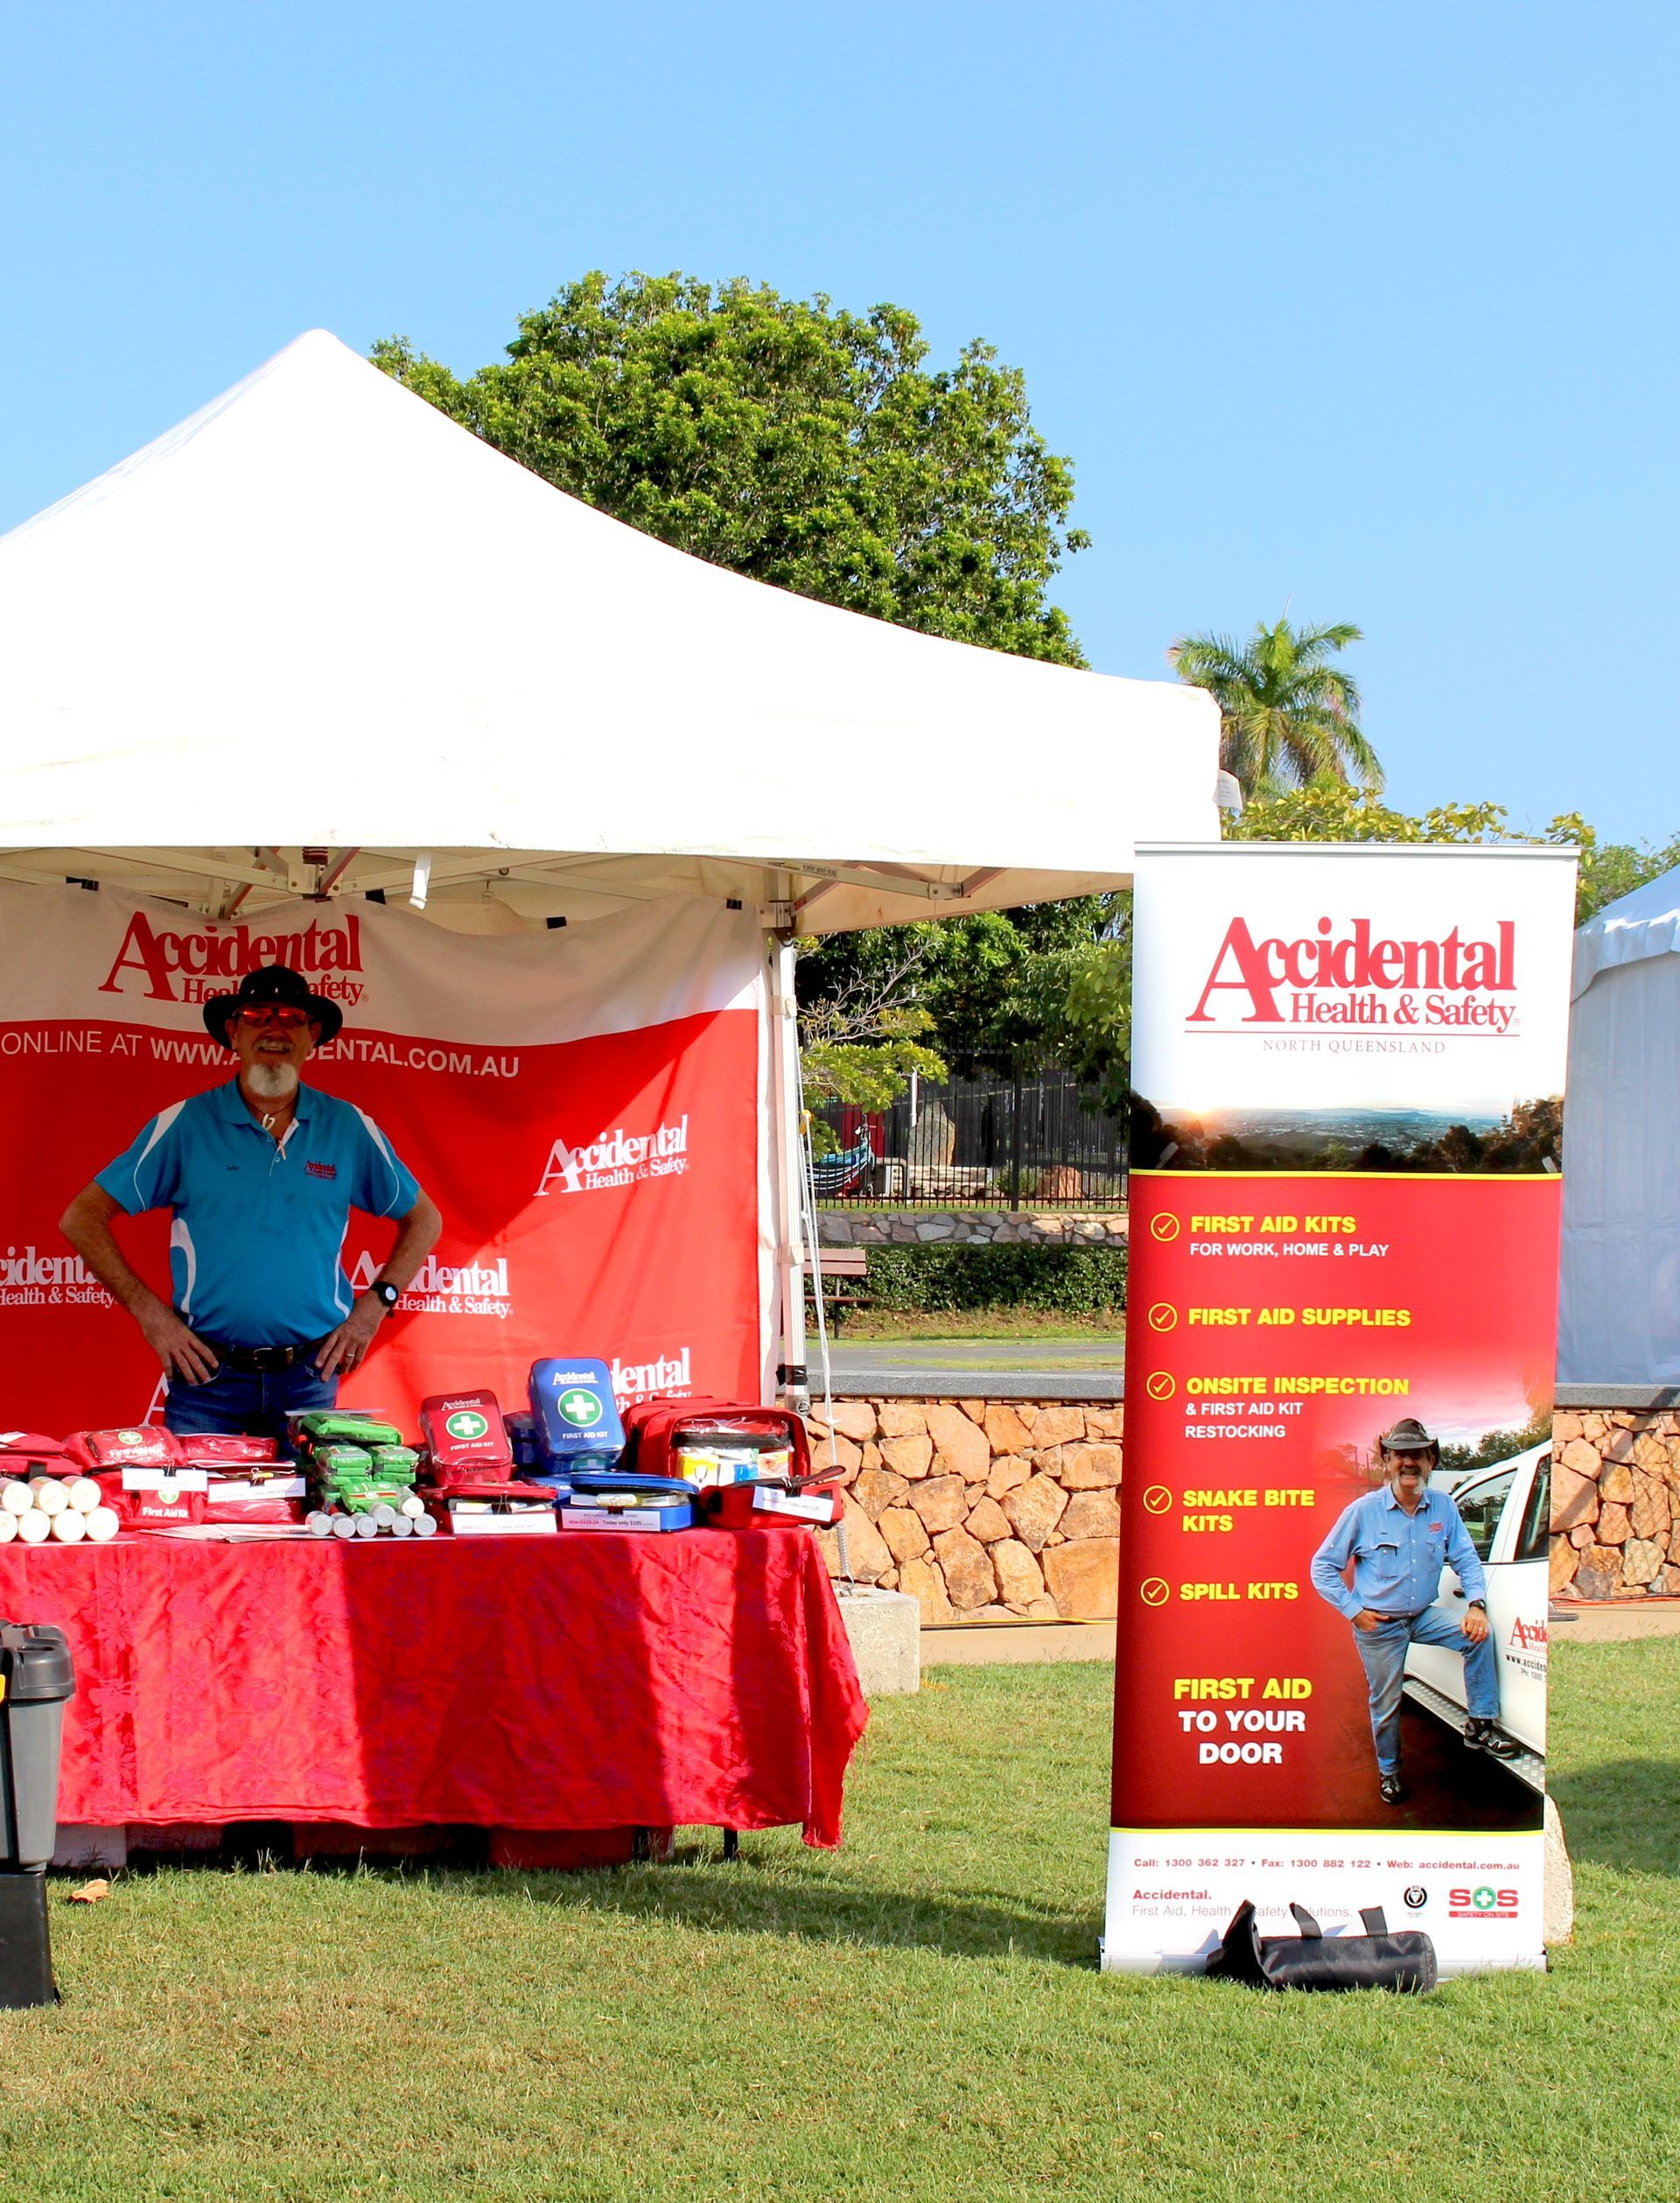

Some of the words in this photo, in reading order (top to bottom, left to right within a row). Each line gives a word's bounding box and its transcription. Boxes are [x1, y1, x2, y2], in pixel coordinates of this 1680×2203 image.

[98, 910, 363, 1001] Accidental
[1186, 916, 1517, 1023] Accidental
[307, 974, 364, 1007] afety
[1290, 993, 1388, 1024] Health
[1394, 993, 1420, 1025] &
[1425, 993, 1516, 1034] Safety
[1, 1031, 102, 1056] ONLINE
[109, 1033, 143, 1056] AT
[1263, 1039, 1322, 1052] NORTH
[1328, 1040, 1446, 1054] QUEENSLAND
[533, 1114, 689, 1196] Accidental
[584, 1168, 634, 1190] Health
[636, 1163, 648, 1182] &
[650, 1156, 688, 1175] Safety
[1191, 1215, 1254, 1233] FIRST
[1260, 1215, 1298, 1233] AID
[1305, 1215, 1356, 1234] KITS
[1190, 1243, 1222, 1256] FOR
[1227, 1243, 1278, 1258] WORK,
[1283, 1243, 1328, 1256] HOME
[1333, 1244, 1344, 1257] &
[1348, 1244, 1390, 1257] PLAY
[48, 1286, 63, 1304] &
[66, 1286, 115, 1309] Safety
[393, 1294, 447, 1313] Health
[448, 1295, 464, 1313] &
[465, 1295, 512, 1319] Safety
[1188, 1308, 1251, 1325] FIRST
[1257, 1308, 1296, 1325] AID
[1301, 1308, 1411, 1327] SUPPLIES
[1186, 1377, 1267, 1394] ONSITE
[1273, 1377, 1410, 1395] INSPECTION
[1185, 1403, 1196, 1415] &
[1201, 1402, 1245, 1415] FIRST
[1248, 1402, 1274, 1415] AID
[1278, 1402, 1304, 1414] KIT
[1185, 1425, 1286, 1438] RESTOCKING
[450, 1442, 469, 1451] FIRST
[1182, 1490, 1257, 1507] SNAKE
[1264, 1489, 1315, 1506] BITE
[143, 1507, 164, 1516] First
[164, 1507, 178, 1517] Aid
[178, 1508, 189, 1519] Kit
[1182, 1515, 1233, 1533] KITS
[1180, 1582, 1241, 1601] SPILL
[1247, 1582, 1298, 1600] KITS
[1173, 1678, 1255, 1700] FIRST
[1262, 1678, 1312, 1700] AID
[1178, 1709, 1217, 1732] TO
[1224, 1709, 1306, 1732] YOUR
[1199, 1742, 1283, 1765] DOOR
[1134, 1858, 1159, 1868] Call:
[1165, 1858, 1193, 1868] 1300
[1197, 1858, 1219, 1867] 362
[1224, 1858, 1245, 1867] 327
[1261, 1859, 1284, 1868] Fax:
[1290, 1859, 1318, 1868] 1300
[1350, 1860, 1371, 1869] 122
[1387, 1860, 1414, 1869] Web:
[1418, 1861, 1521, 1870] accidental.com.au
[1132, 1889, 1213, 1900] Accidental.
[1448, 1885, 1519, 1910] SOS
[1132, 1905, 1159, 1916] First
[1163, 1905, 1187, 1918] Aid,
[1192, 1905, 1232, 1917] Health
[1309, 1906, 1354, 1919] lutions.
